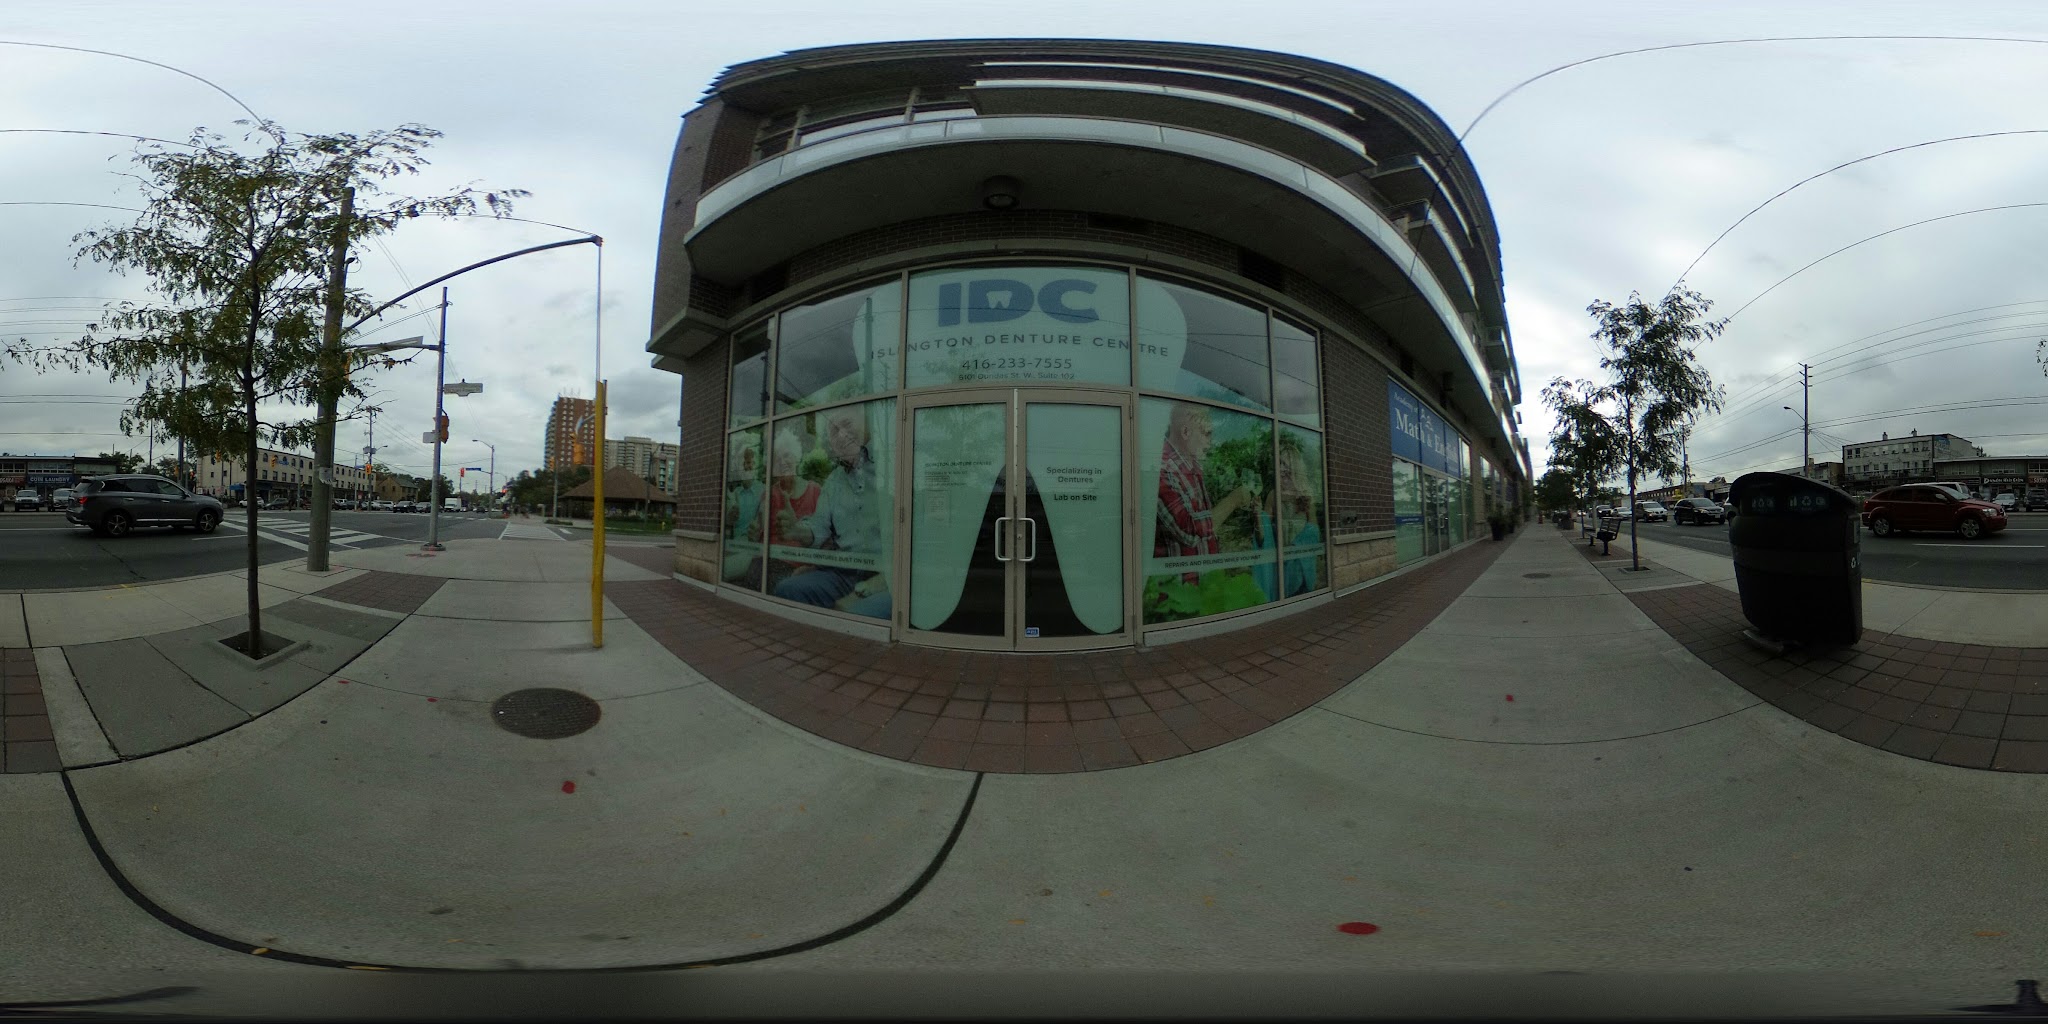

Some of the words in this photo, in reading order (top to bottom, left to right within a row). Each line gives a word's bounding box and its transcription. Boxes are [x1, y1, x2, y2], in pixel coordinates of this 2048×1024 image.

[938, 279, 1099, 327] IDC
[985, 333, 1082, 346] DENTURE
[1092, 336, 1169, 357] CENTRE
[962, 357, 1073, 370] 416-233-7555
[1395, 407, 1425, 444] Math
[1046, 466, 1093, 476] Specializing
[1094, 467, 1102, 475] in
[1057, 476, 1093, 484] Dentures
[1053, 493, 1069, 501] Lab
[1082, 493, 1097, 501] Site
[1165, 561, 1189, 569] REPAIRS
